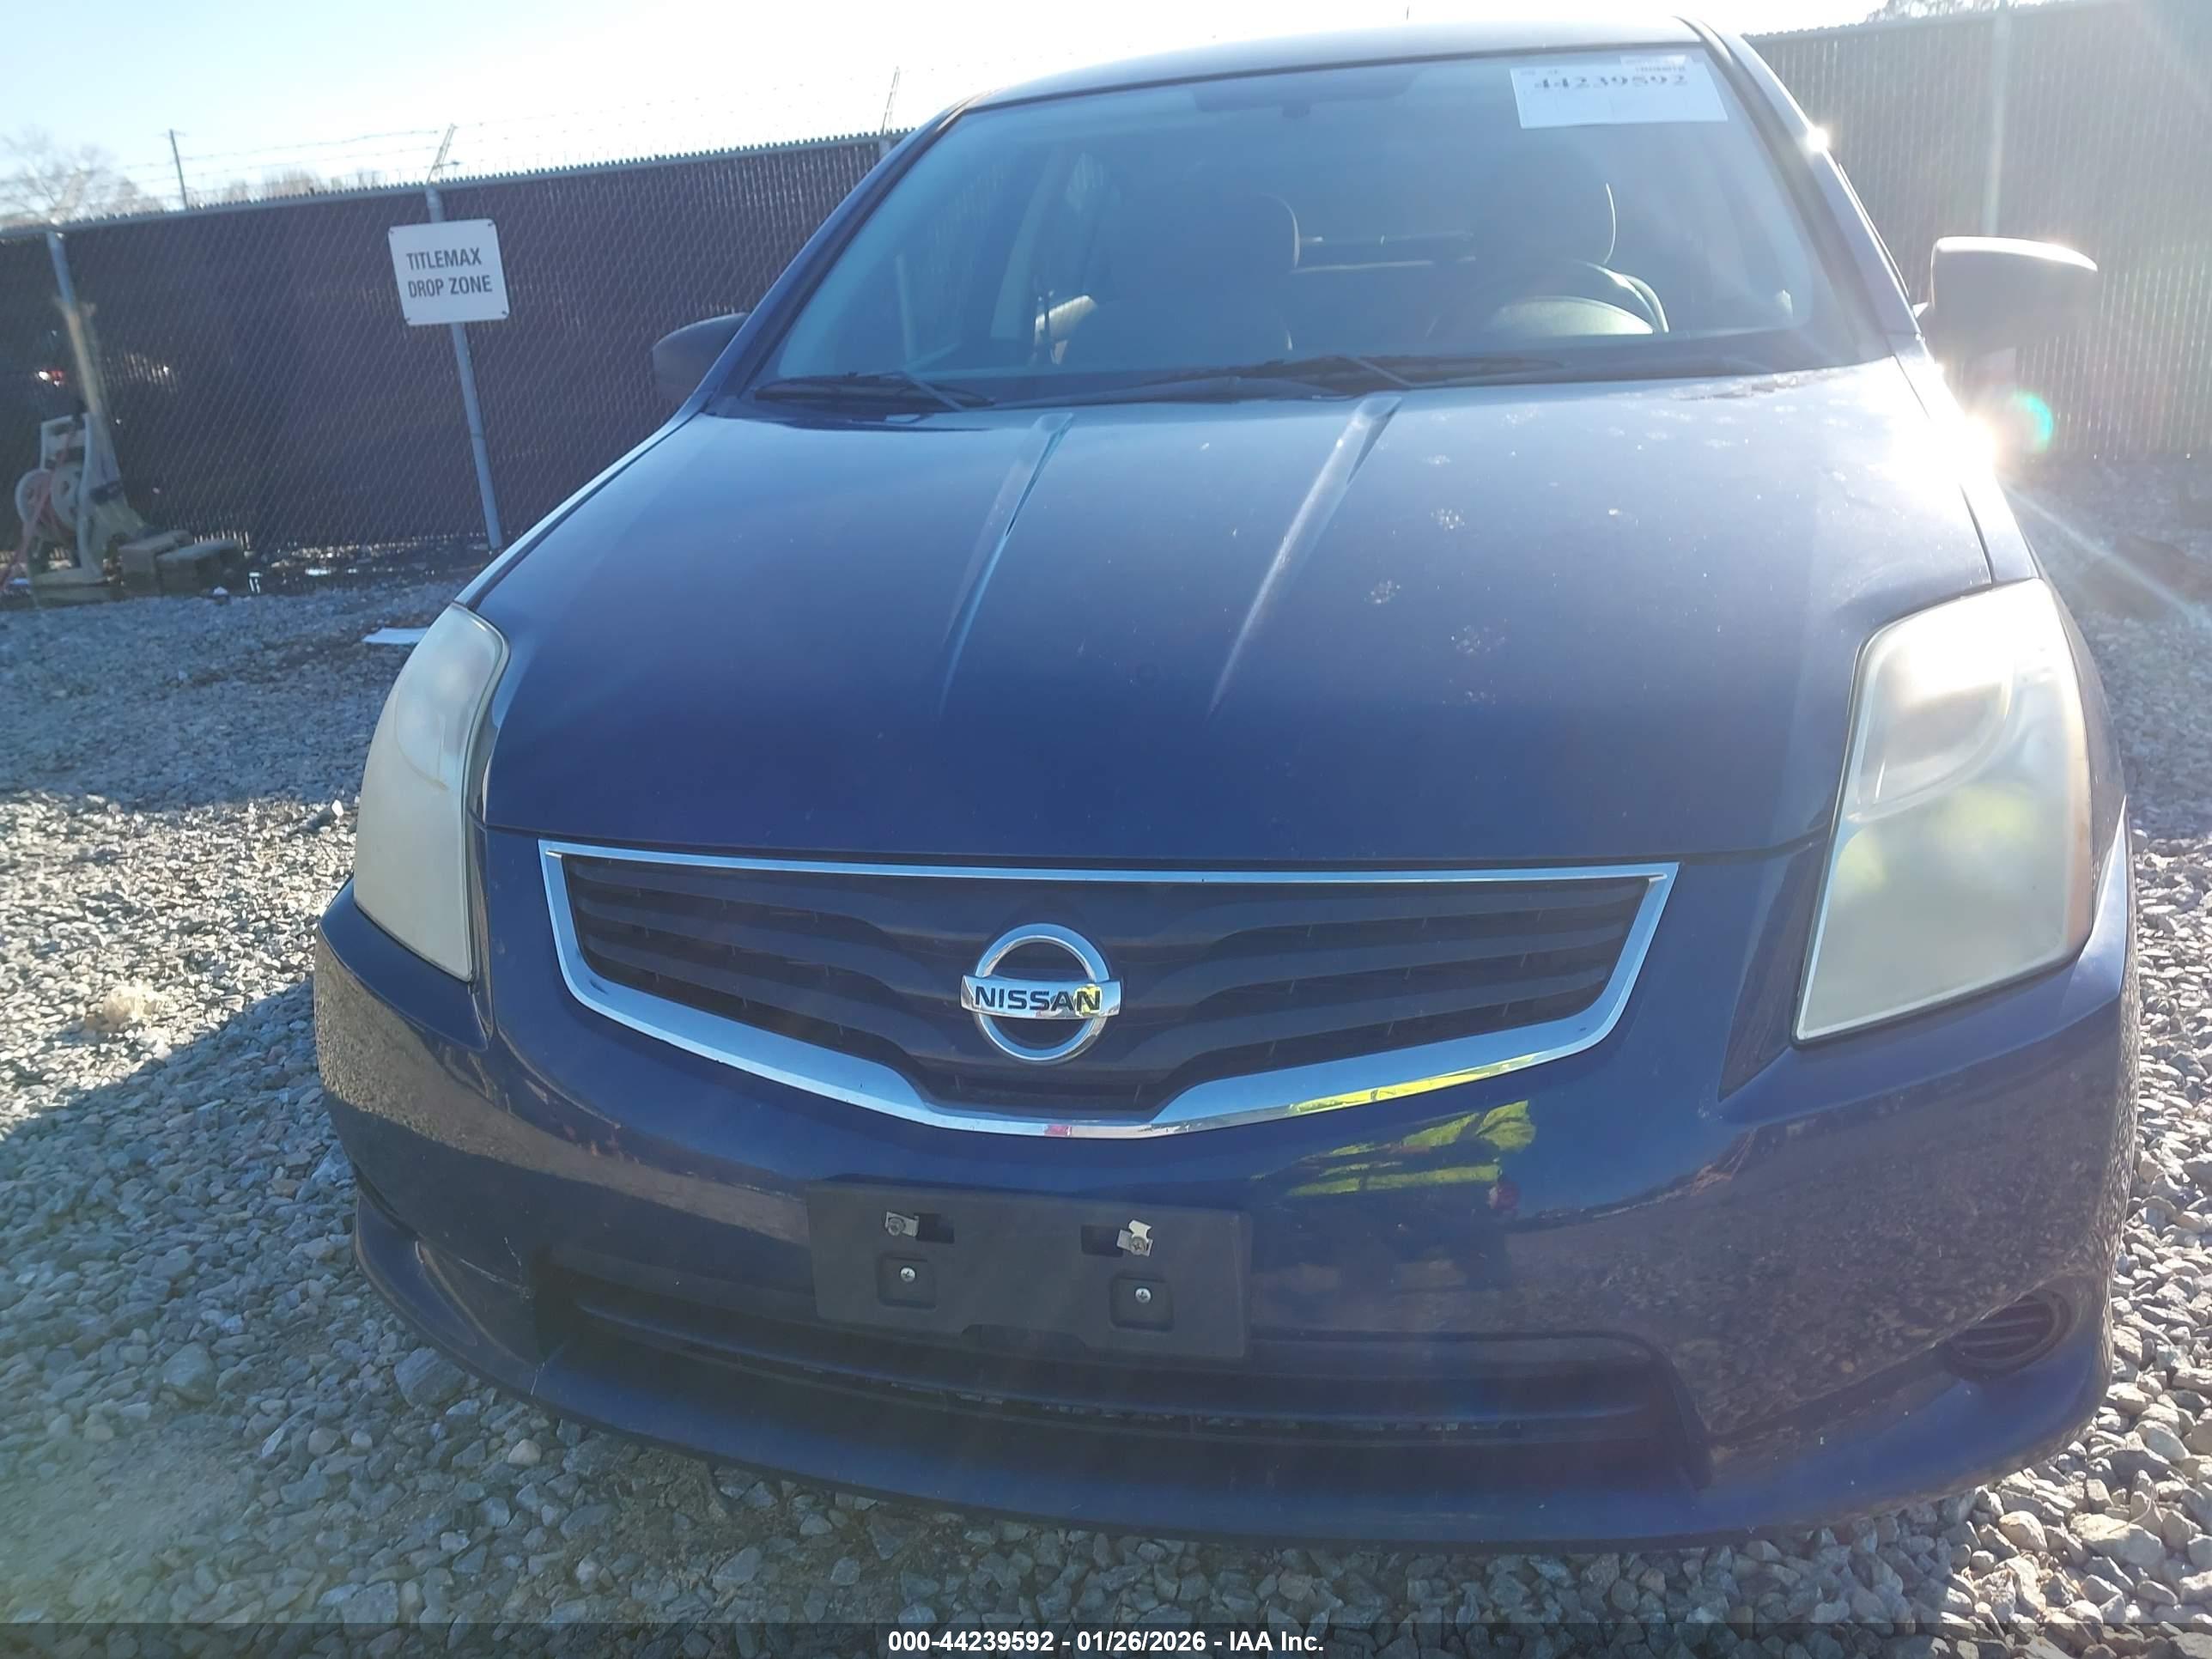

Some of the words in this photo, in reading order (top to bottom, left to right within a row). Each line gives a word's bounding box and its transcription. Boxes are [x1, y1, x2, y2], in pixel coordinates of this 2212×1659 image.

[406, 247, 483, 270] TITLEMAX
[408, 279, 444, 298] DROP
[449, 275, 493, 295] ZONE
[975, 986, 1101, 1012] NISSAN
